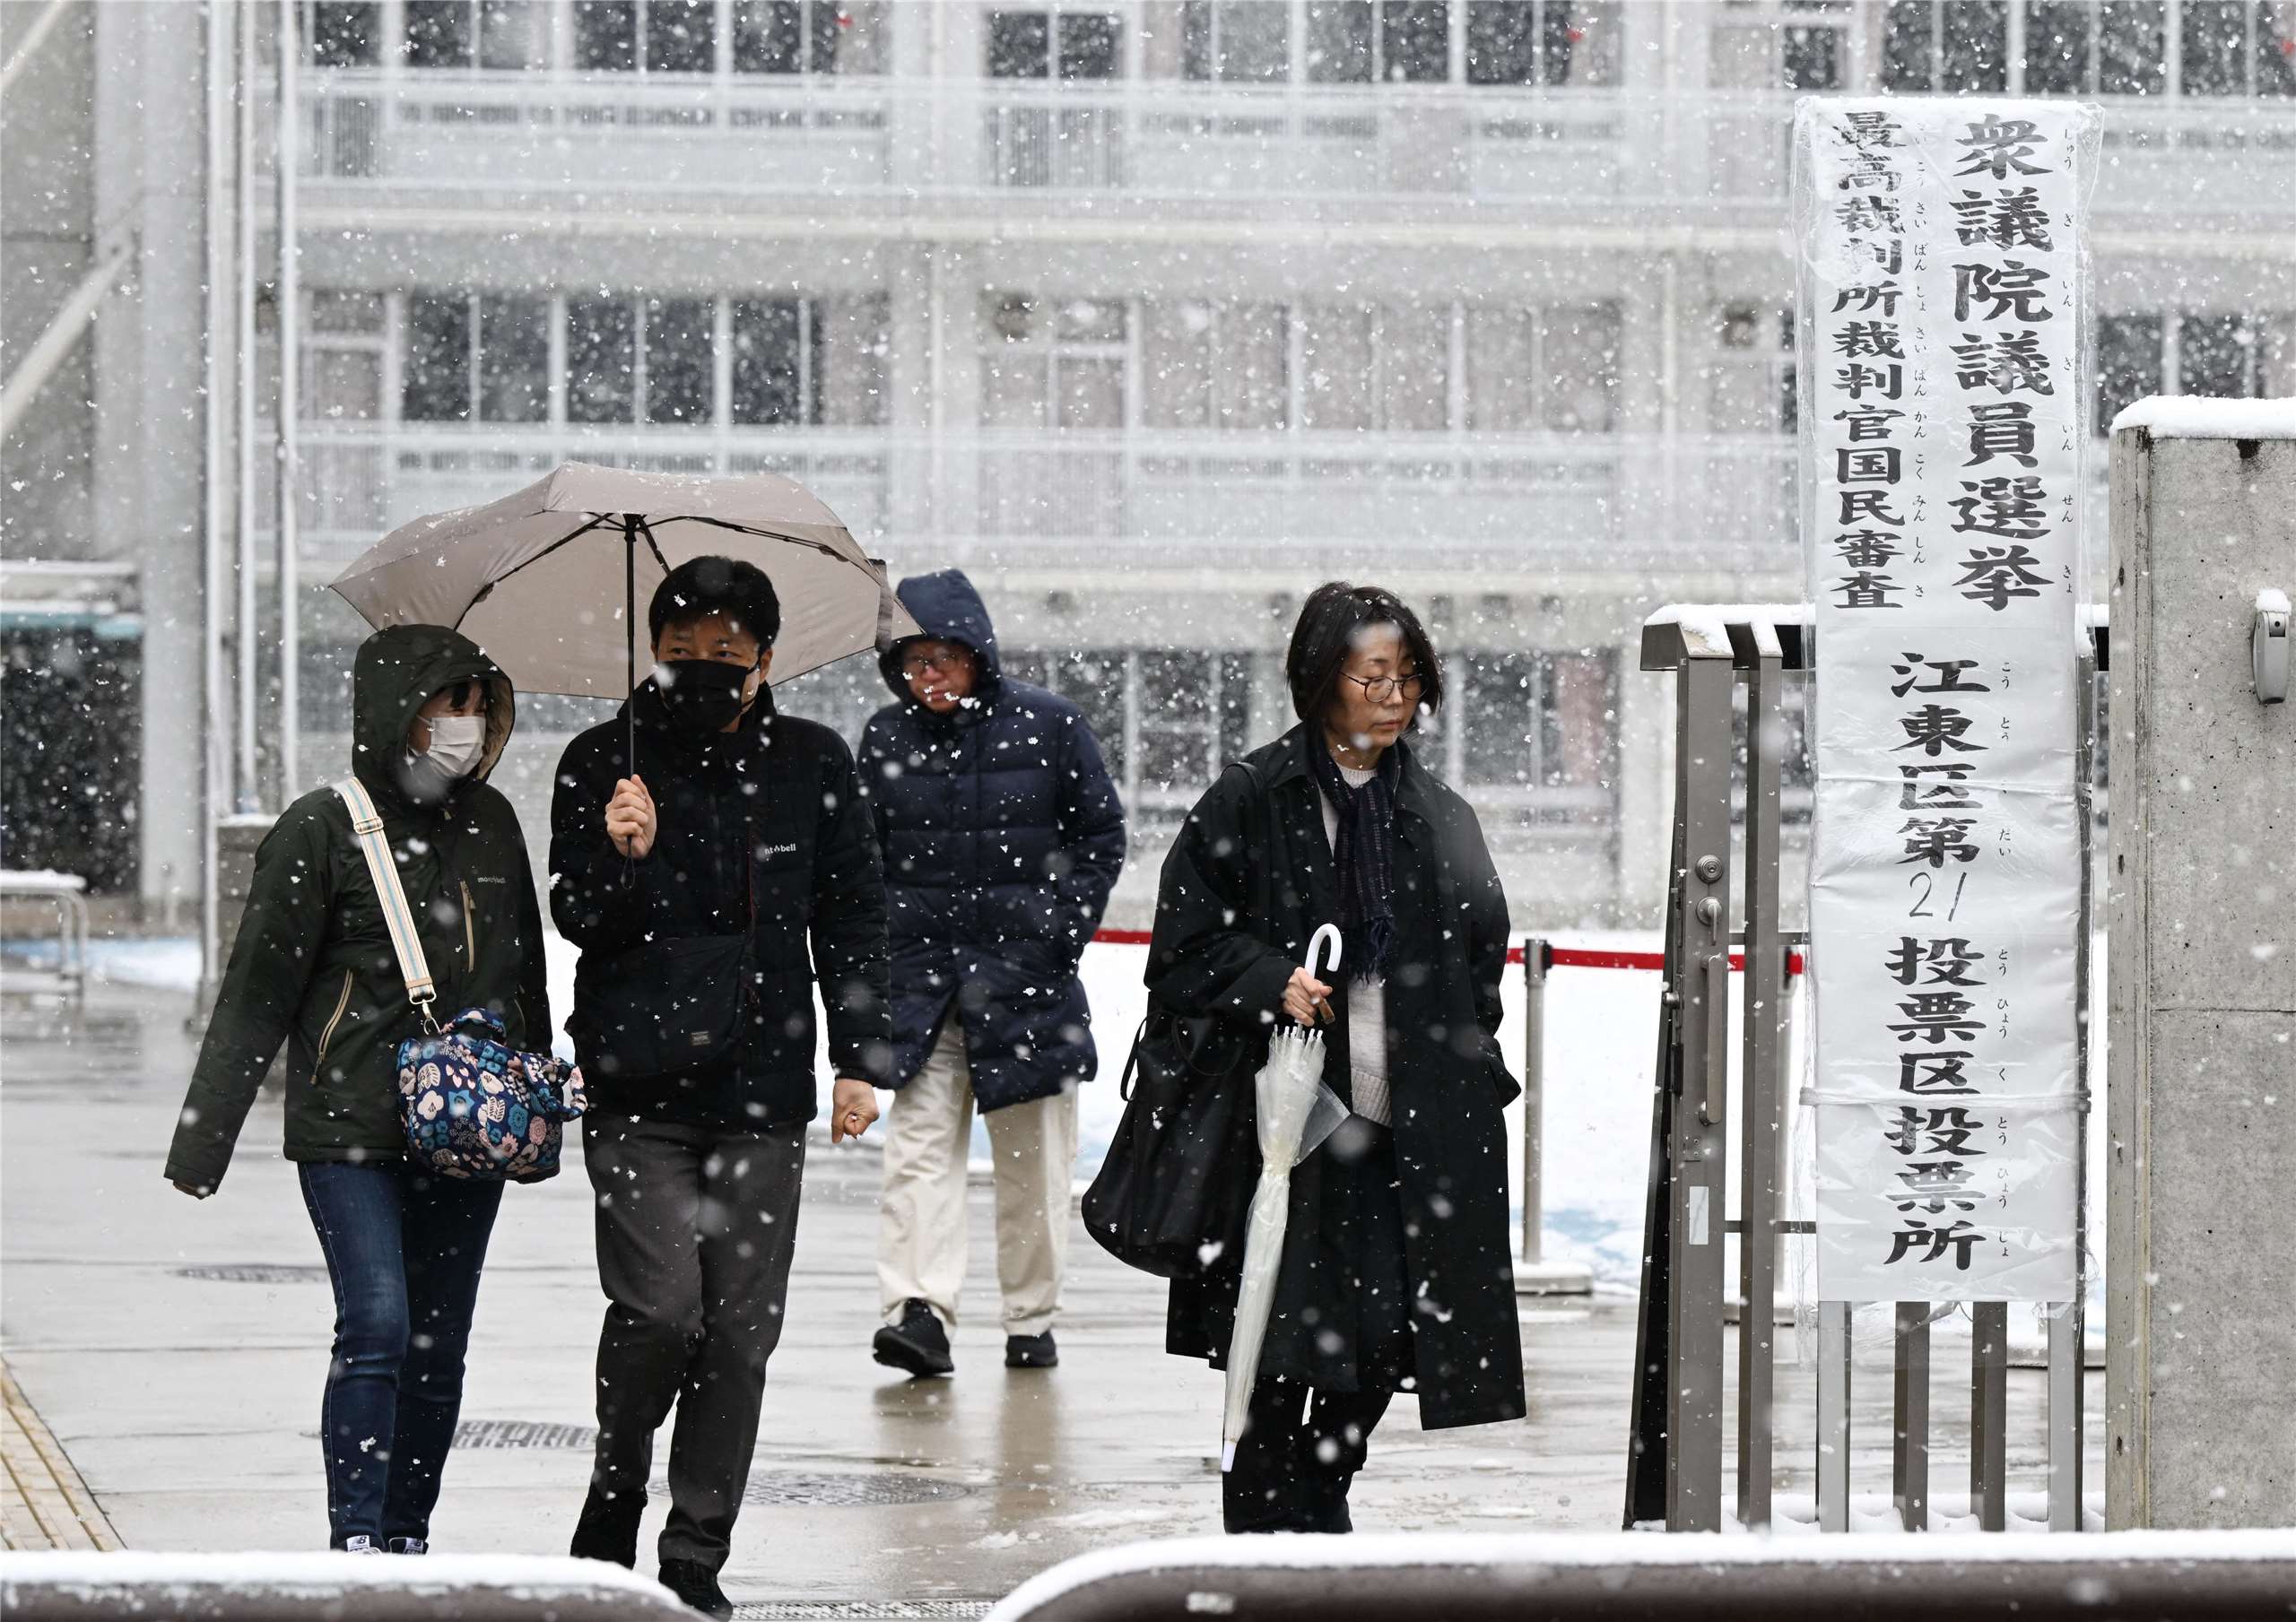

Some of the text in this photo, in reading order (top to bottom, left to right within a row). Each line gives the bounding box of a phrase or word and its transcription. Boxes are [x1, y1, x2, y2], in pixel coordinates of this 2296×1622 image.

[1830, 110, 1908, 609] 最高裁判所裁判官国民審査
[1947, 113, 2056, 612] 衆議院議員選挙
